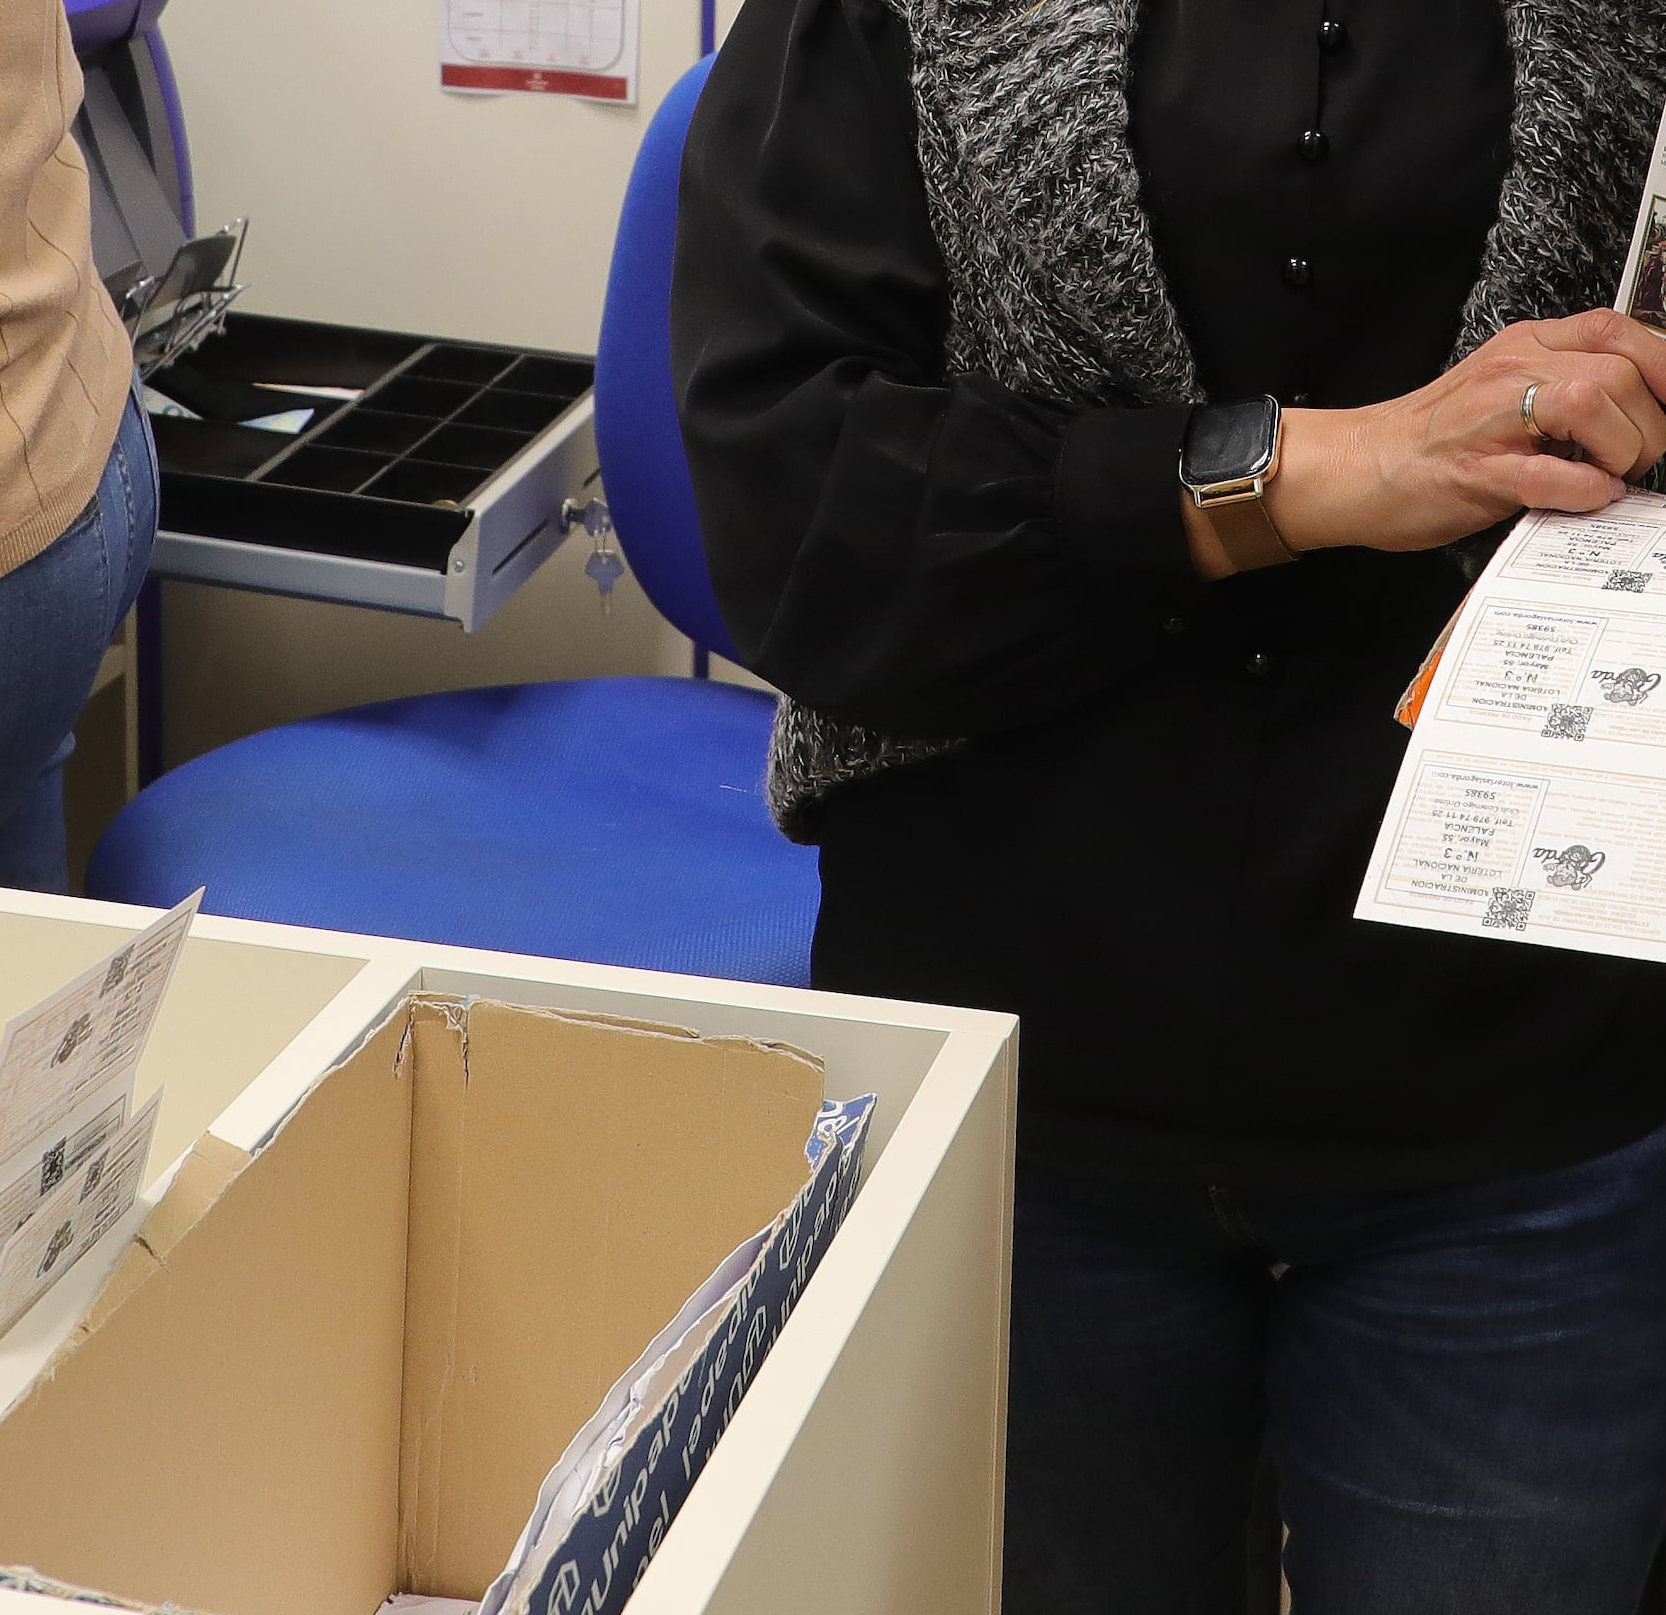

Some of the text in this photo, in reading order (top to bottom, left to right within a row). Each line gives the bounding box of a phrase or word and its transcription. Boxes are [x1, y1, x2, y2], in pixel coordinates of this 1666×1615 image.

[1465, 788, 1496, 800] 59385
[1432, 809, 1443, 817] 25
[1446, 811, 1456, 819] 11
[1459, 813, 1471, 821] 74
[1473, 815, 1490, 823] 979
[1444, 822, 1495, 836] PALENCIA
[1442, 833, 1454, 842] 55
[1443, 847, 1453, 859] 3
[1413, 858, 1503, 876] LOTERIA NACIONAL
[1441, 872, 1468, 883] DE LA
